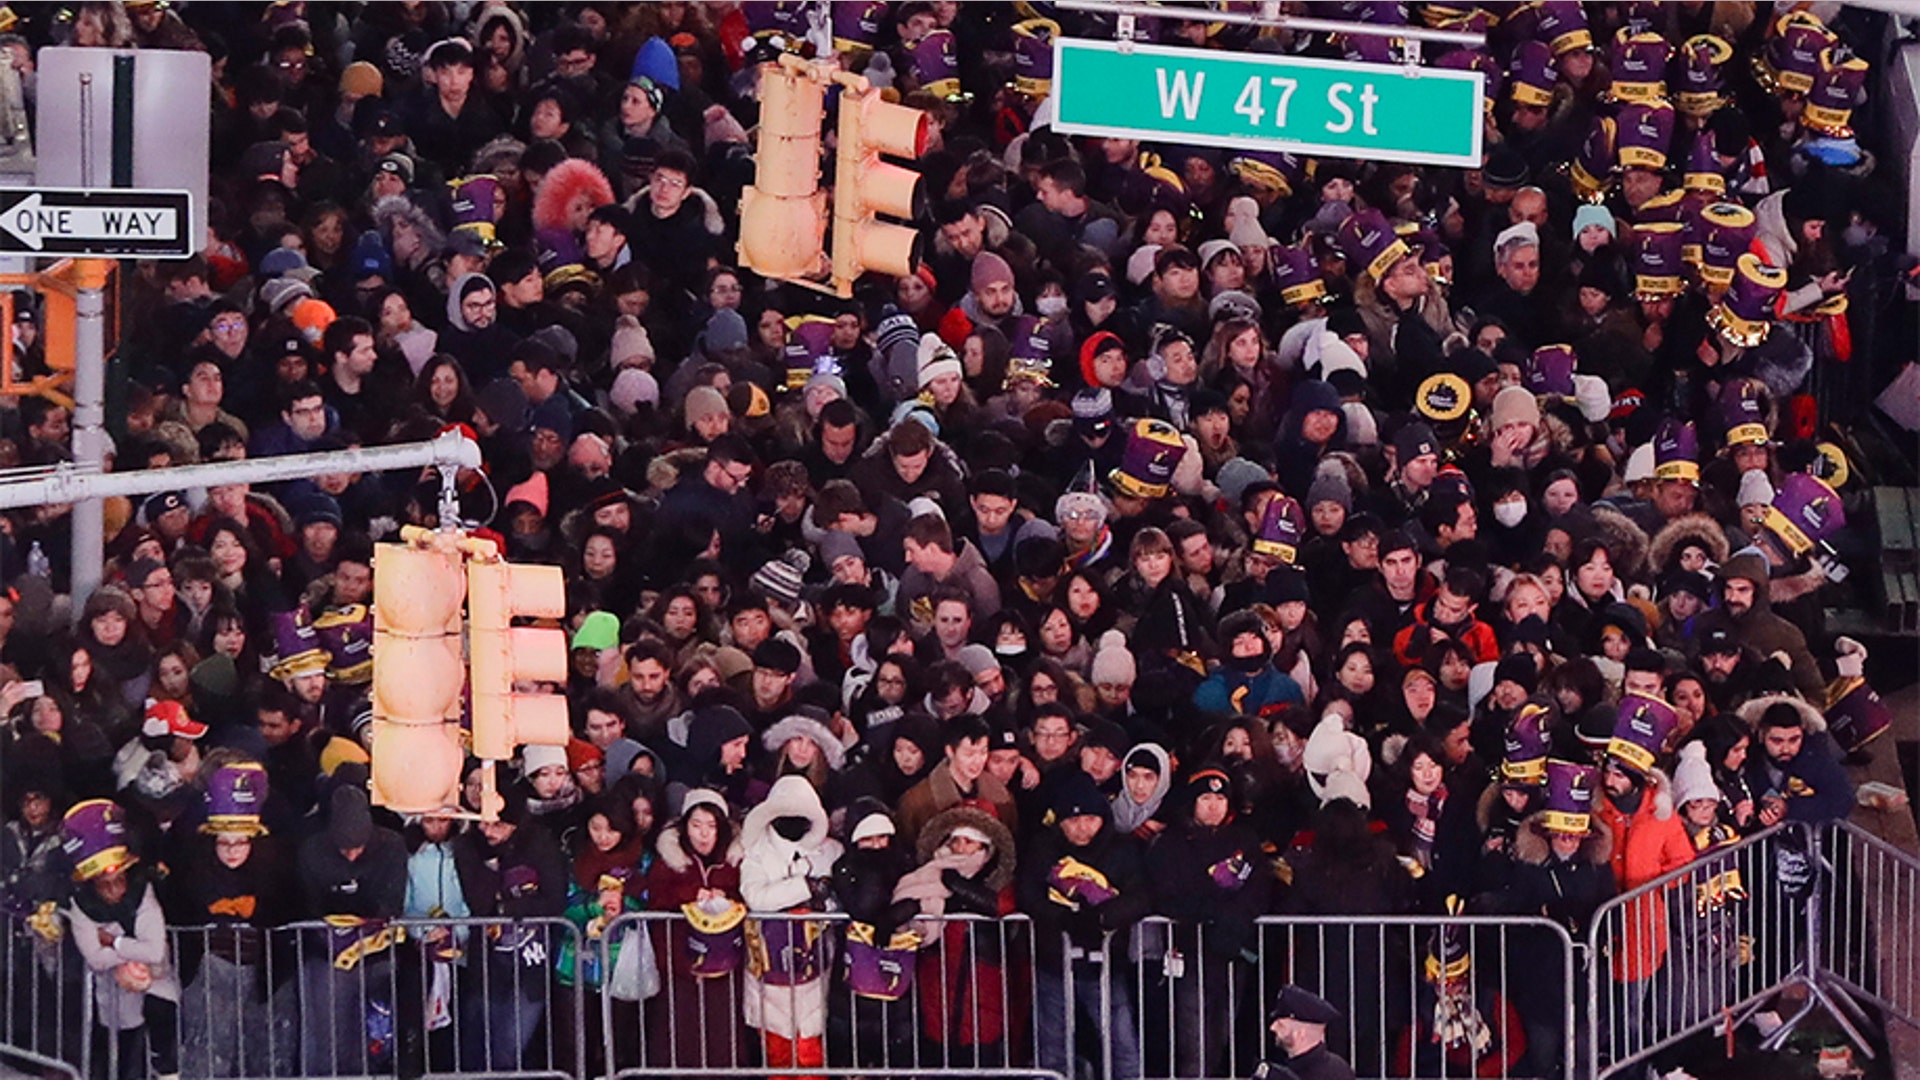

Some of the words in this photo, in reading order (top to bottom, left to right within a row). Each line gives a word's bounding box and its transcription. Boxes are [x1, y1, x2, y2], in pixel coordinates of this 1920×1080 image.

[1155, 67, 1205, 120] W
[1234, 75, 1298, 127] 47
[1325, 82, 1379, 135] St
[16, 209, 72, 233] ONE
[102, 212, 162, 235] WAY
